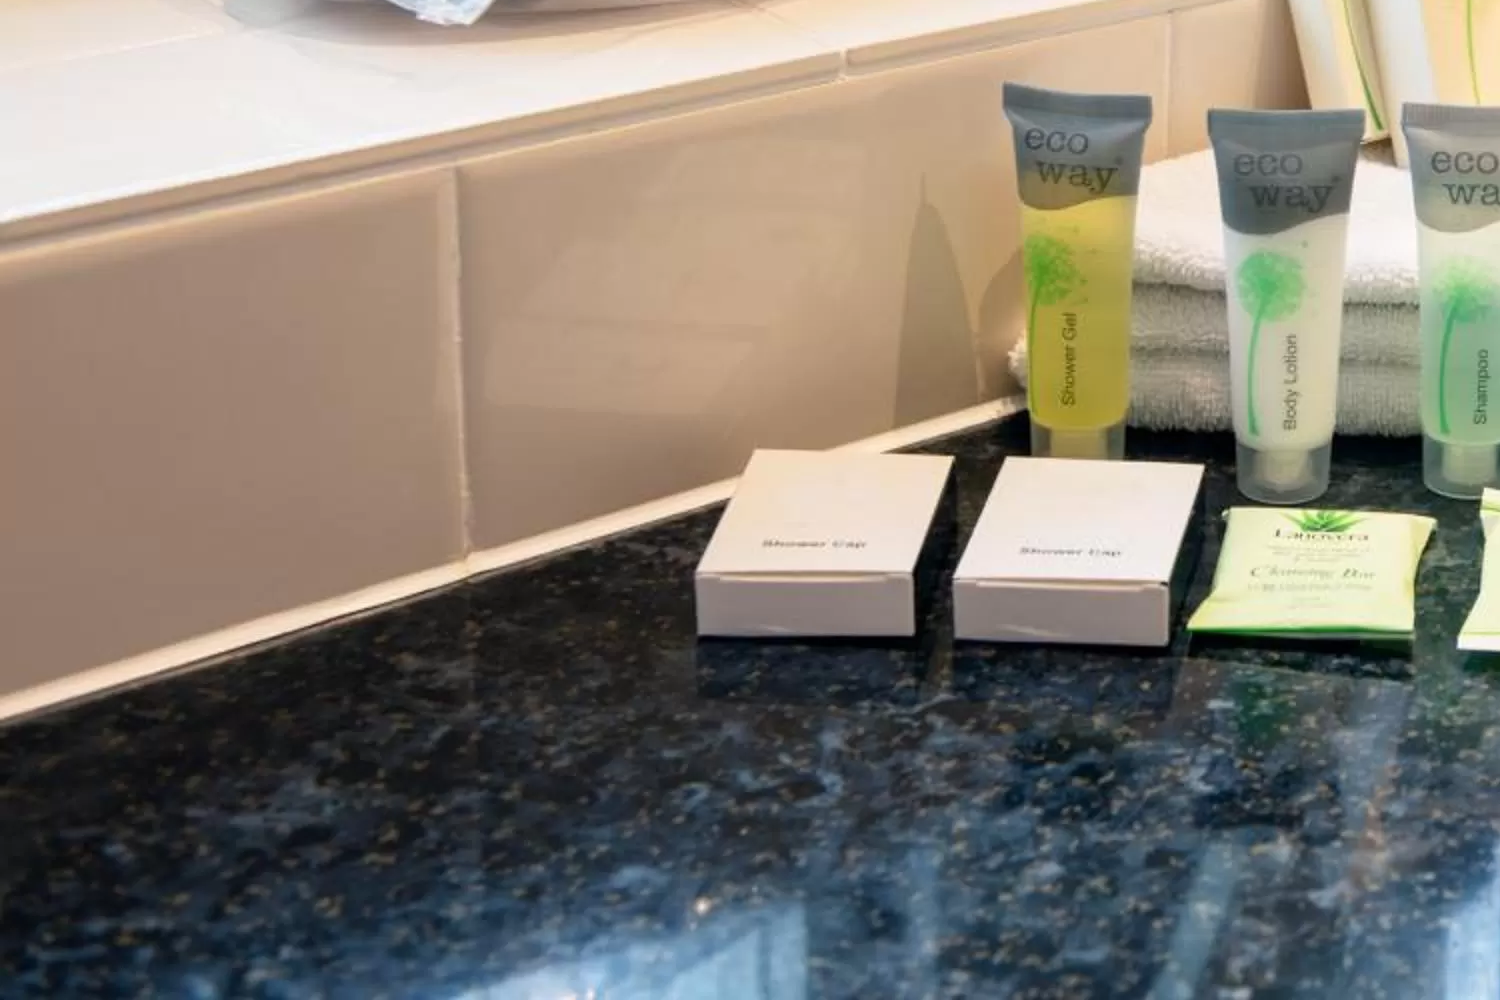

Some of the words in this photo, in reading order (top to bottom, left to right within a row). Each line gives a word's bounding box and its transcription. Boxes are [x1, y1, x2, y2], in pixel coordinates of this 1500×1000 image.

[1024, 126, 1089, 155] eco
[1035, 159, 1119, 195] way
[1234, 151, 1304, 177] eco
[1431, 149, 1499, 176] eco
[1249, 183, 1335, 212] way
[1061, 311, 1078, 341] Gel
[1060, 343, 1077, 408] Shower
[1284, 333, 1298, 385] Lotion
[1474, 348, 1491, 424] Shampoo
[1282, 388, 1301, 431] Body
